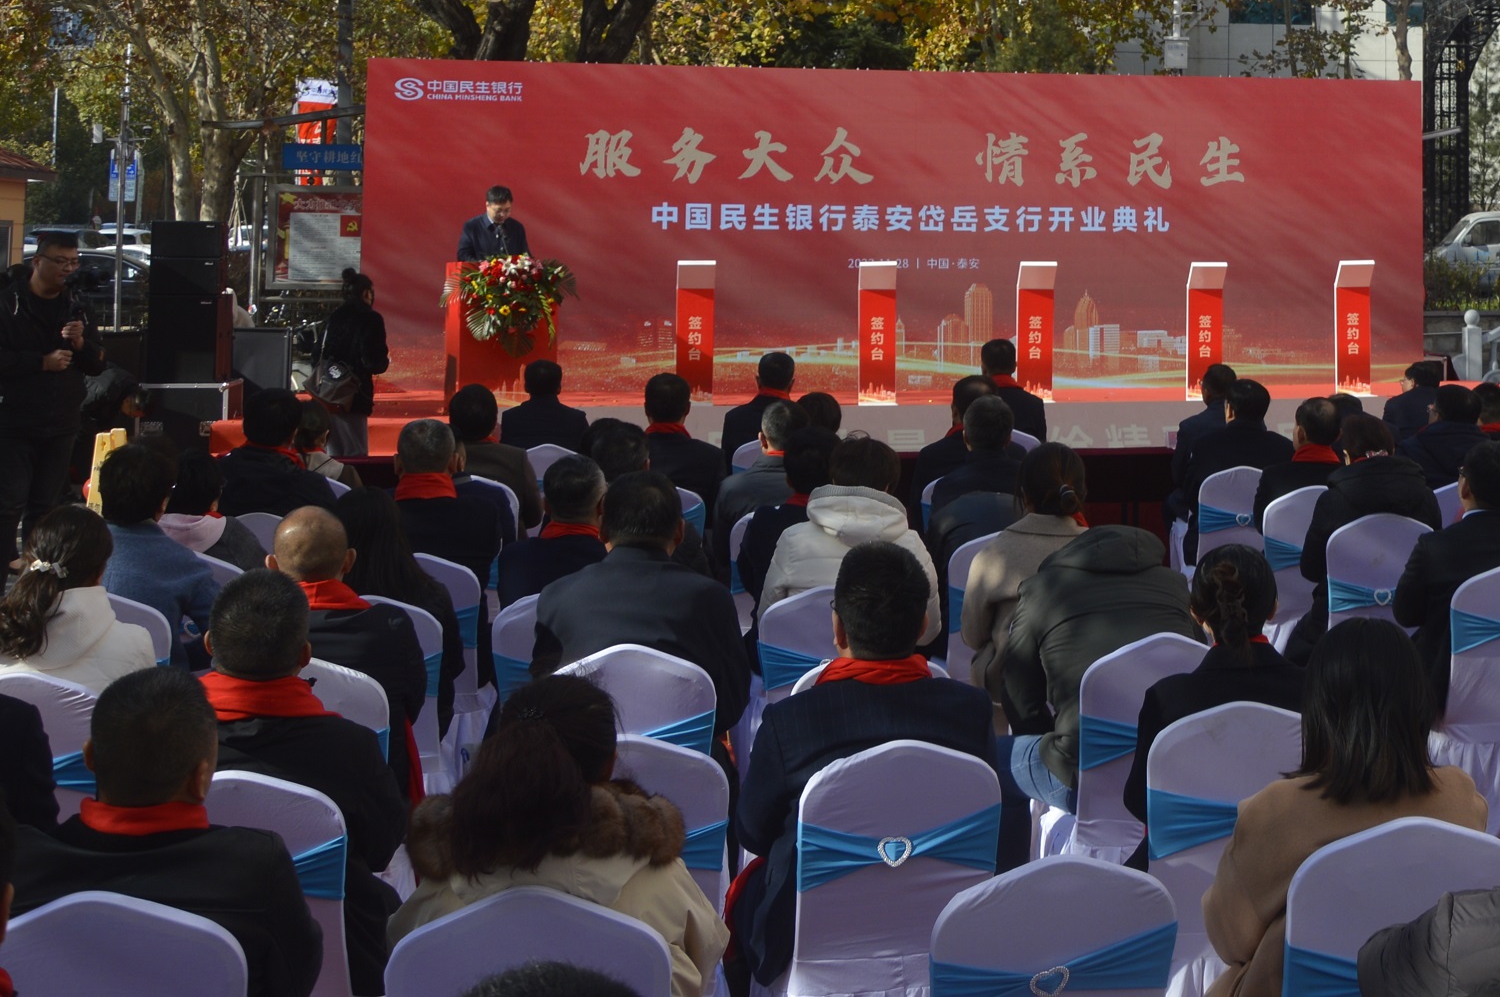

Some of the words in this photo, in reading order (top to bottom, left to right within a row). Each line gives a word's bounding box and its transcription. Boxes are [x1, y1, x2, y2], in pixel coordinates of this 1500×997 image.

[427, 80, 523, 95] 中国民生银行
[455, 94, 498, 102] MINSHENG
[580, 127, 874, 185] 服务大众
[976, 132, 1246, 190] 情系民生
[651, 201, 1171, 233] 中国民生银行泰安岱岳支行开业典礼
[688, 316, 702, 361] 签约台
[870, 316, 884, 361] 签约台
[1028, 315, 1042, 360] 签约台
[1198, 314, 1212, 358] 签约台
[1346, 312, 1360, 355] 签约台
